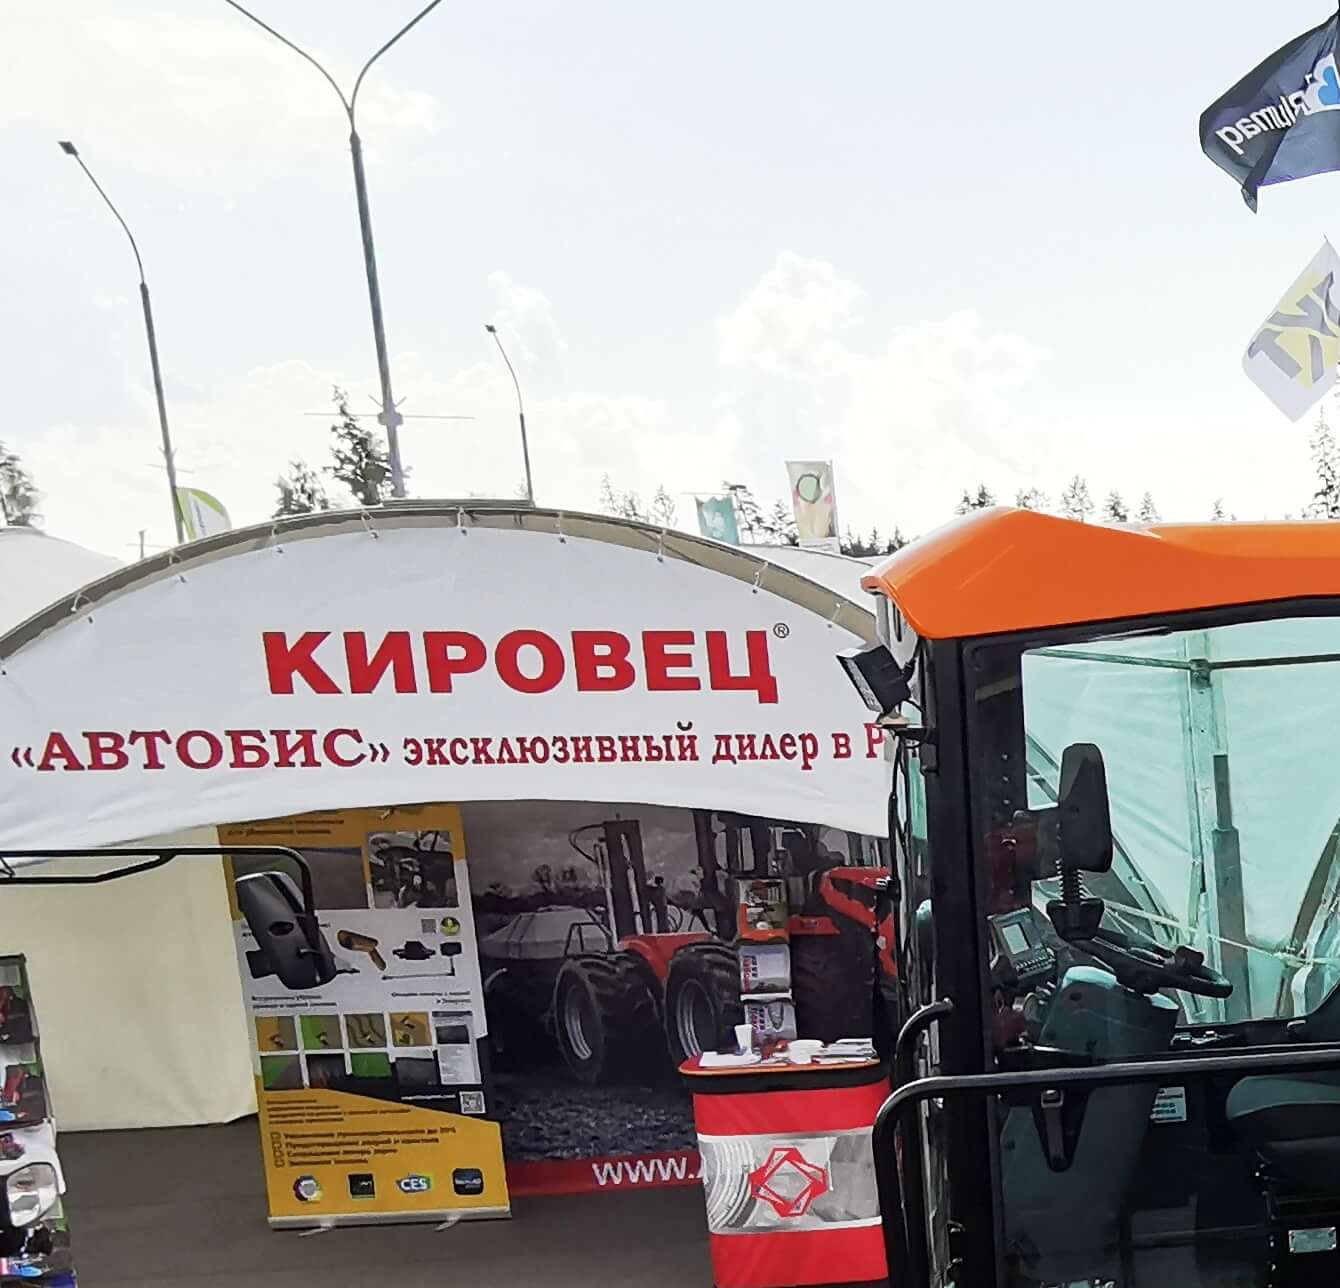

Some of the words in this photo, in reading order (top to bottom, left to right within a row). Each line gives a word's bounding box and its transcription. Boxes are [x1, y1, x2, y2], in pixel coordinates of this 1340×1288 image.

[12, 728, 389, 771] «АВТОБИС»
[403, 722, 704, 768] эксклюзивный
[712, 732, 821, 769] дилер
[832, 735, 852, 760] в
[401, 1178, 428, 1192] CES
